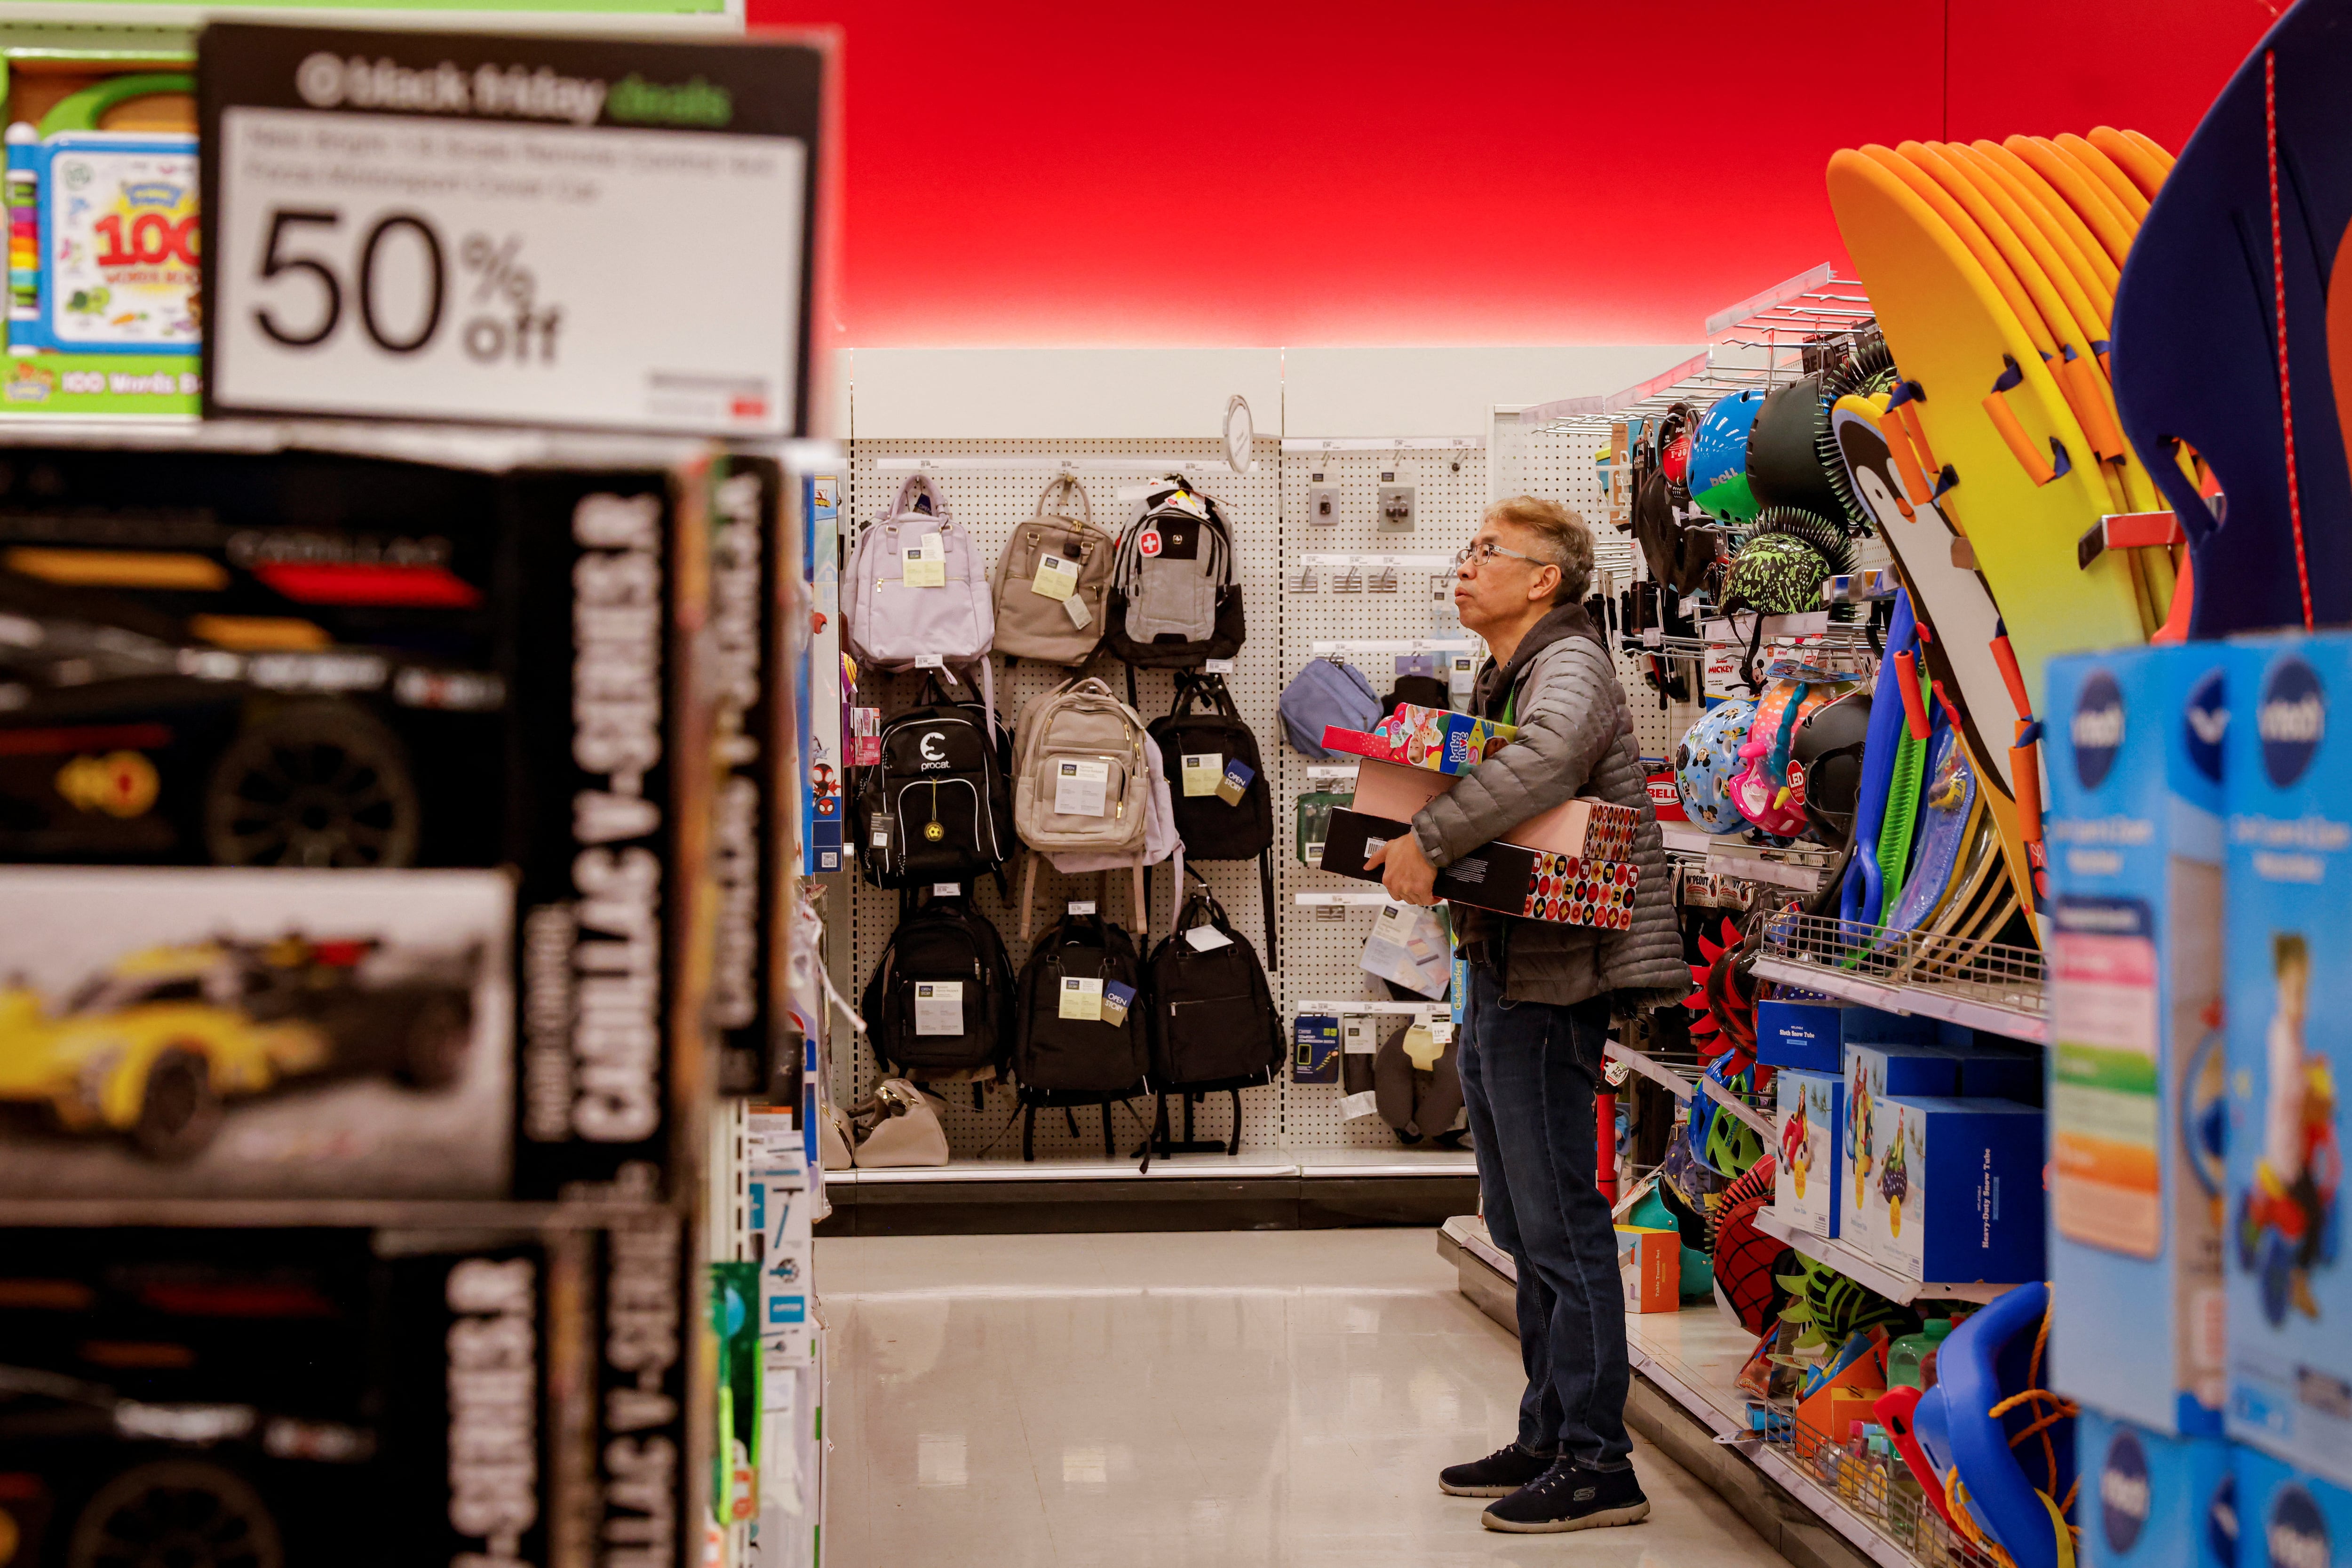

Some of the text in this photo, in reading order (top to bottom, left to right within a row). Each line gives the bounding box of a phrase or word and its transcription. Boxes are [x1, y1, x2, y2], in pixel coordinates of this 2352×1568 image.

[345, 56, 732, 127] black friday deals
[254, 207, 445, 356] 50
[462, 303, 562, 366] off
[1709, 467, 1738, 487] bell
[1708, 665, 1733, 674] MICKEY
[1450, 732, 1461, 762] baby
[1459, 732, 1469, 762] alive
[921, 760, 949, 772] procat
[1224, 778, 1242, 792] STORY
[1228, 772, 1246, 786] OPEN
[1788, 772, 1804, 788] LED
[1647, 788, 1678, 798] BELL
[1105, 1000, 1124, 1012] STORY
[1108, 993, 1127, 1006] OPEN
[1611, 1070, 1621, 1079] Me!
[1615, 1066, 1624, 1075] Try
[1982, 1198, 1991, 1248] Heavy-Duty
